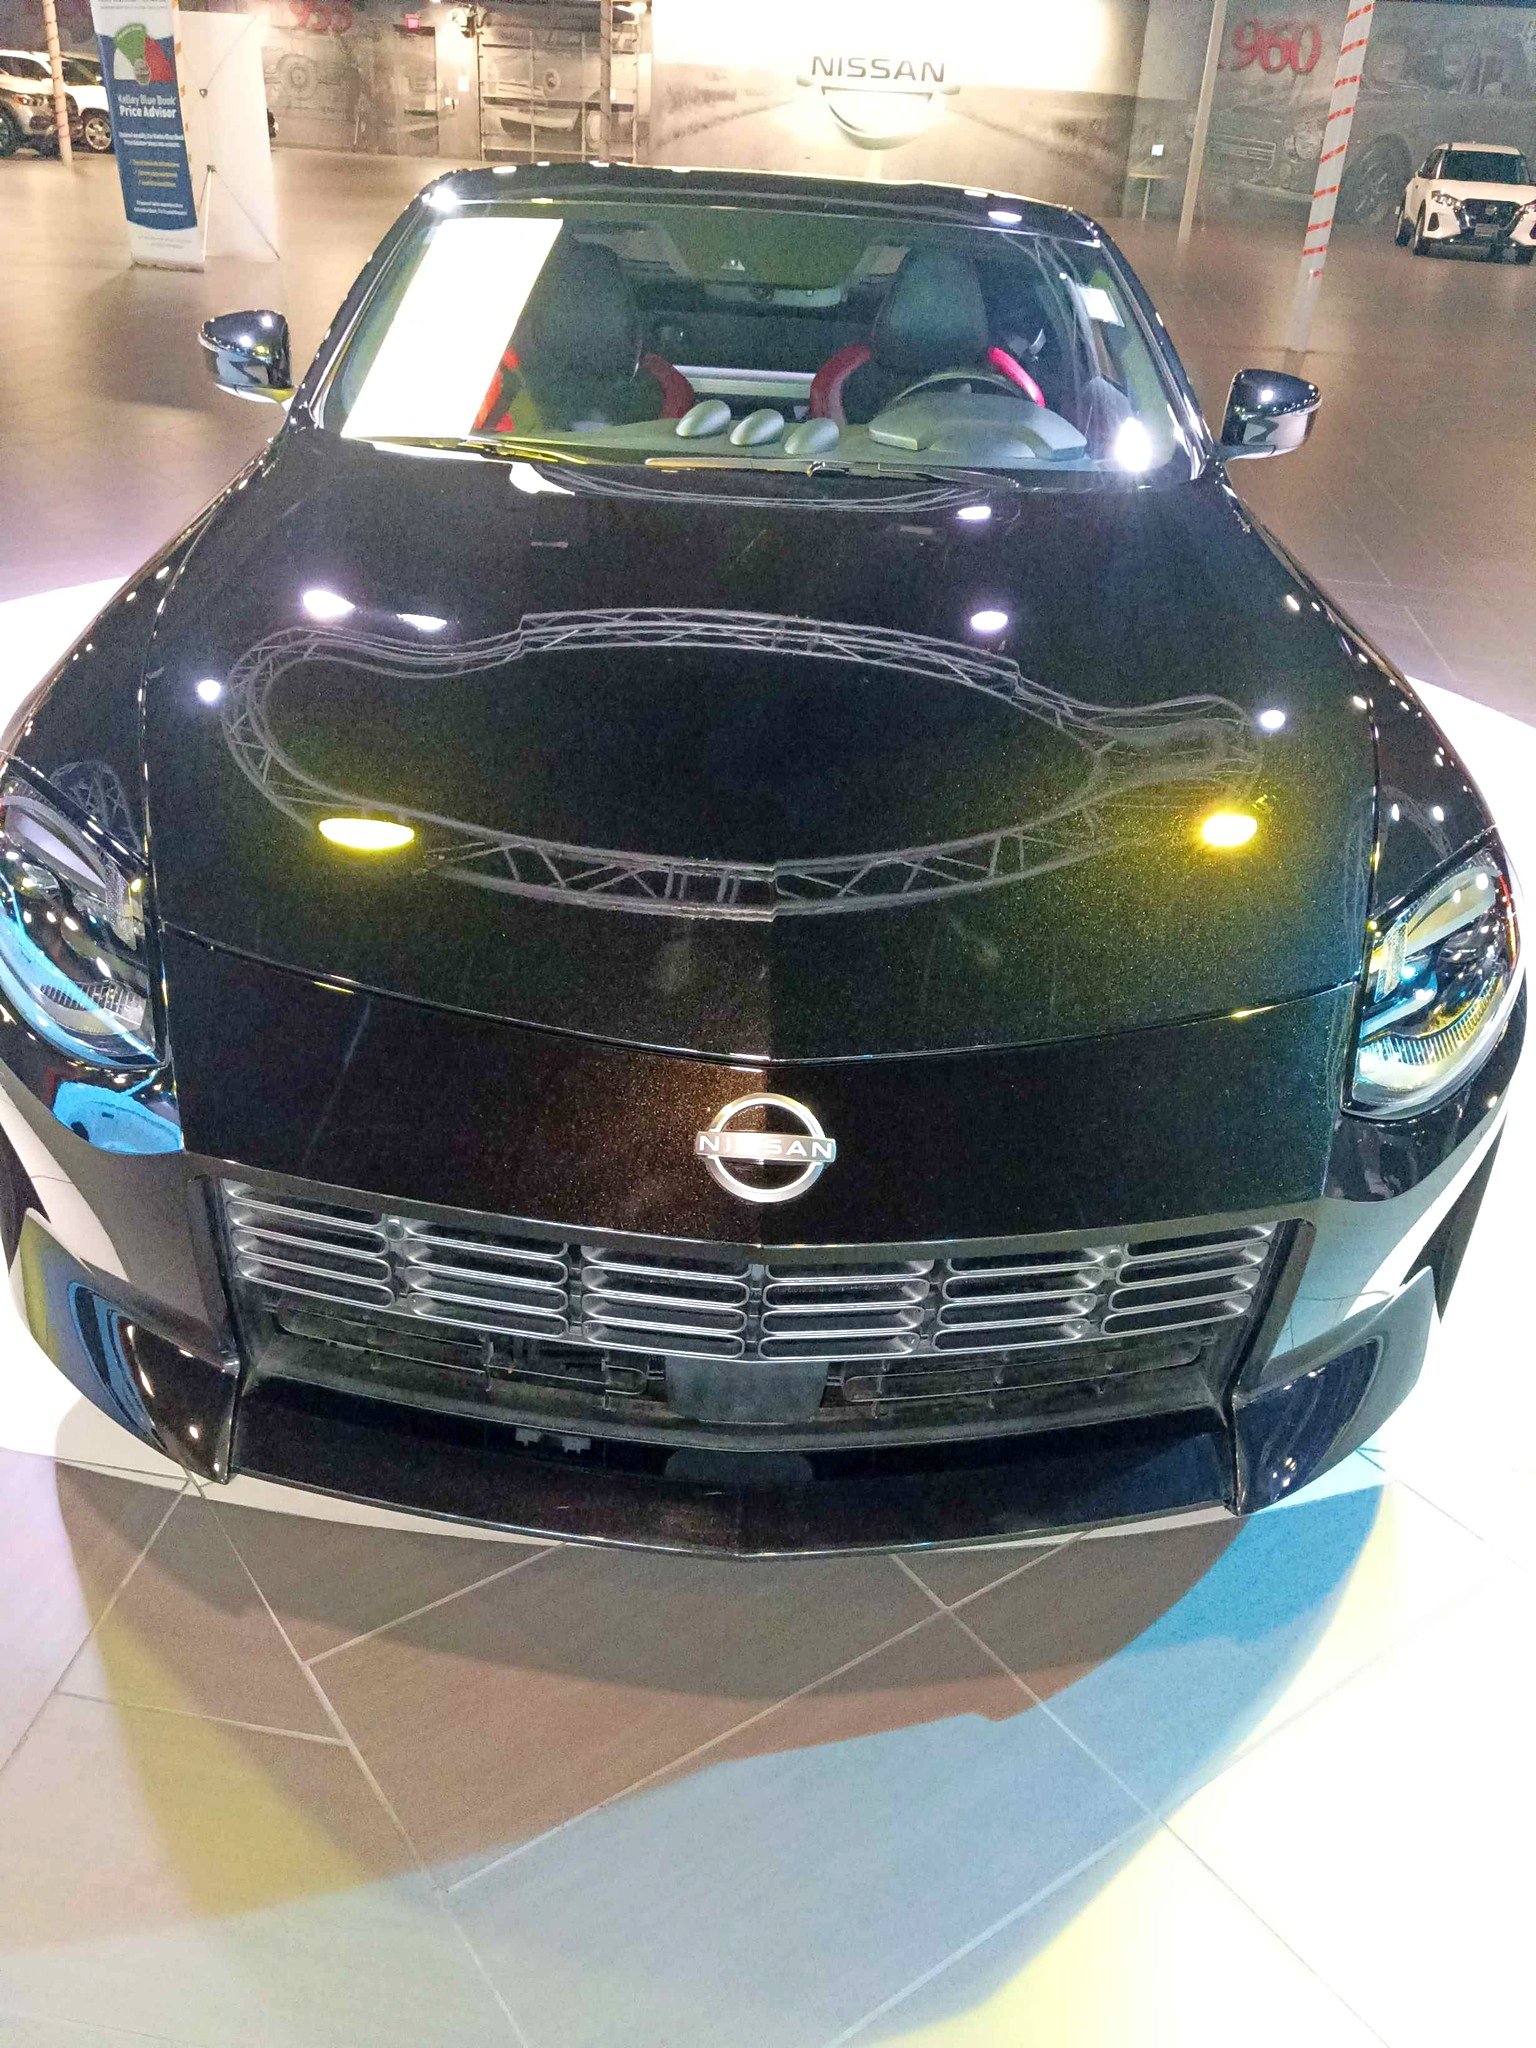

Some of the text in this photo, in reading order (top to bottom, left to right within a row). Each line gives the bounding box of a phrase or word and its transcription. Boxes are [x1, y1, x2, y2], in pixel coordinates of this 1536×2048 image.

[1217, 19, 1322, 74] 960
[811, 55, 945, 83] NISSAN
[119, 105, 142, 117] Price
[698, 1134, 833, 1160] NISAN
